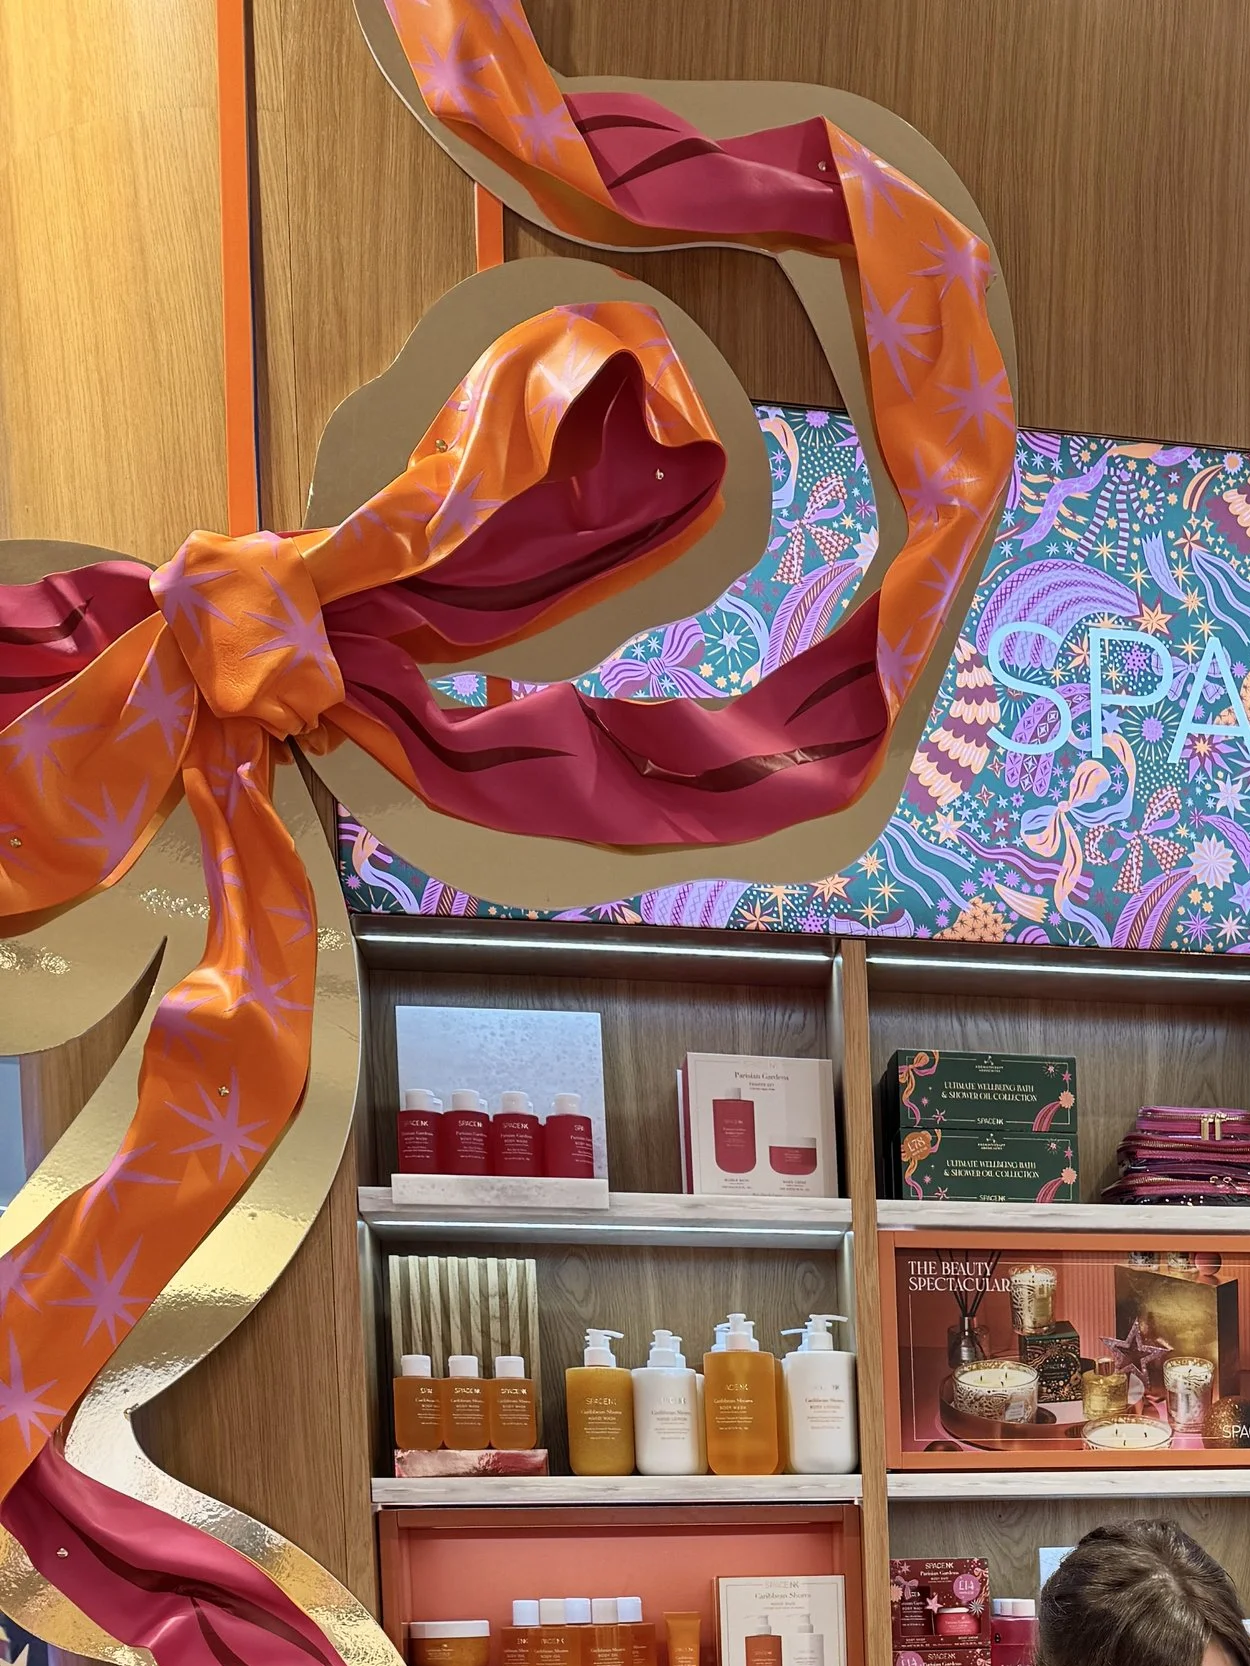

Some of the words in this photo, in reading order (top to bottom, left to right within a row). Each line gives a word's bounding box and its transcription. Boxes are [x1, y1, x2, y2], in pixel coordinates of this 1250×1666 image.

[944, 1081, 976, 1090] ULTIMATE
[977, 1082, 1015, 1092] WELLBEING
[1016, 1084, 1034, 1093] BATH
[949, 1092, 979, 1100] SHOWER
[979, 1092, 992, 1100] OIL
[993, 1092, 1038, 1101] COLLECTION
[946, 1159, 978, 1168] ULTIMATE
[979, 1160, 1018, 1169] WELLBEING
[1018, 1161, 1036, 1169] BATH
[943, 1169, 949, 1177] &
[950, 1169, 981, 1177] SHOWER
[981, 1169, 993, 1177] OIL
[994, 1170, 1040, 1178] COLLECTION
[907, 1260, 938, 1276] THE
[942, 1261, 994, 1278] BEAUTY
[908, 1276, 1012, 1293] SPECTACULAR
